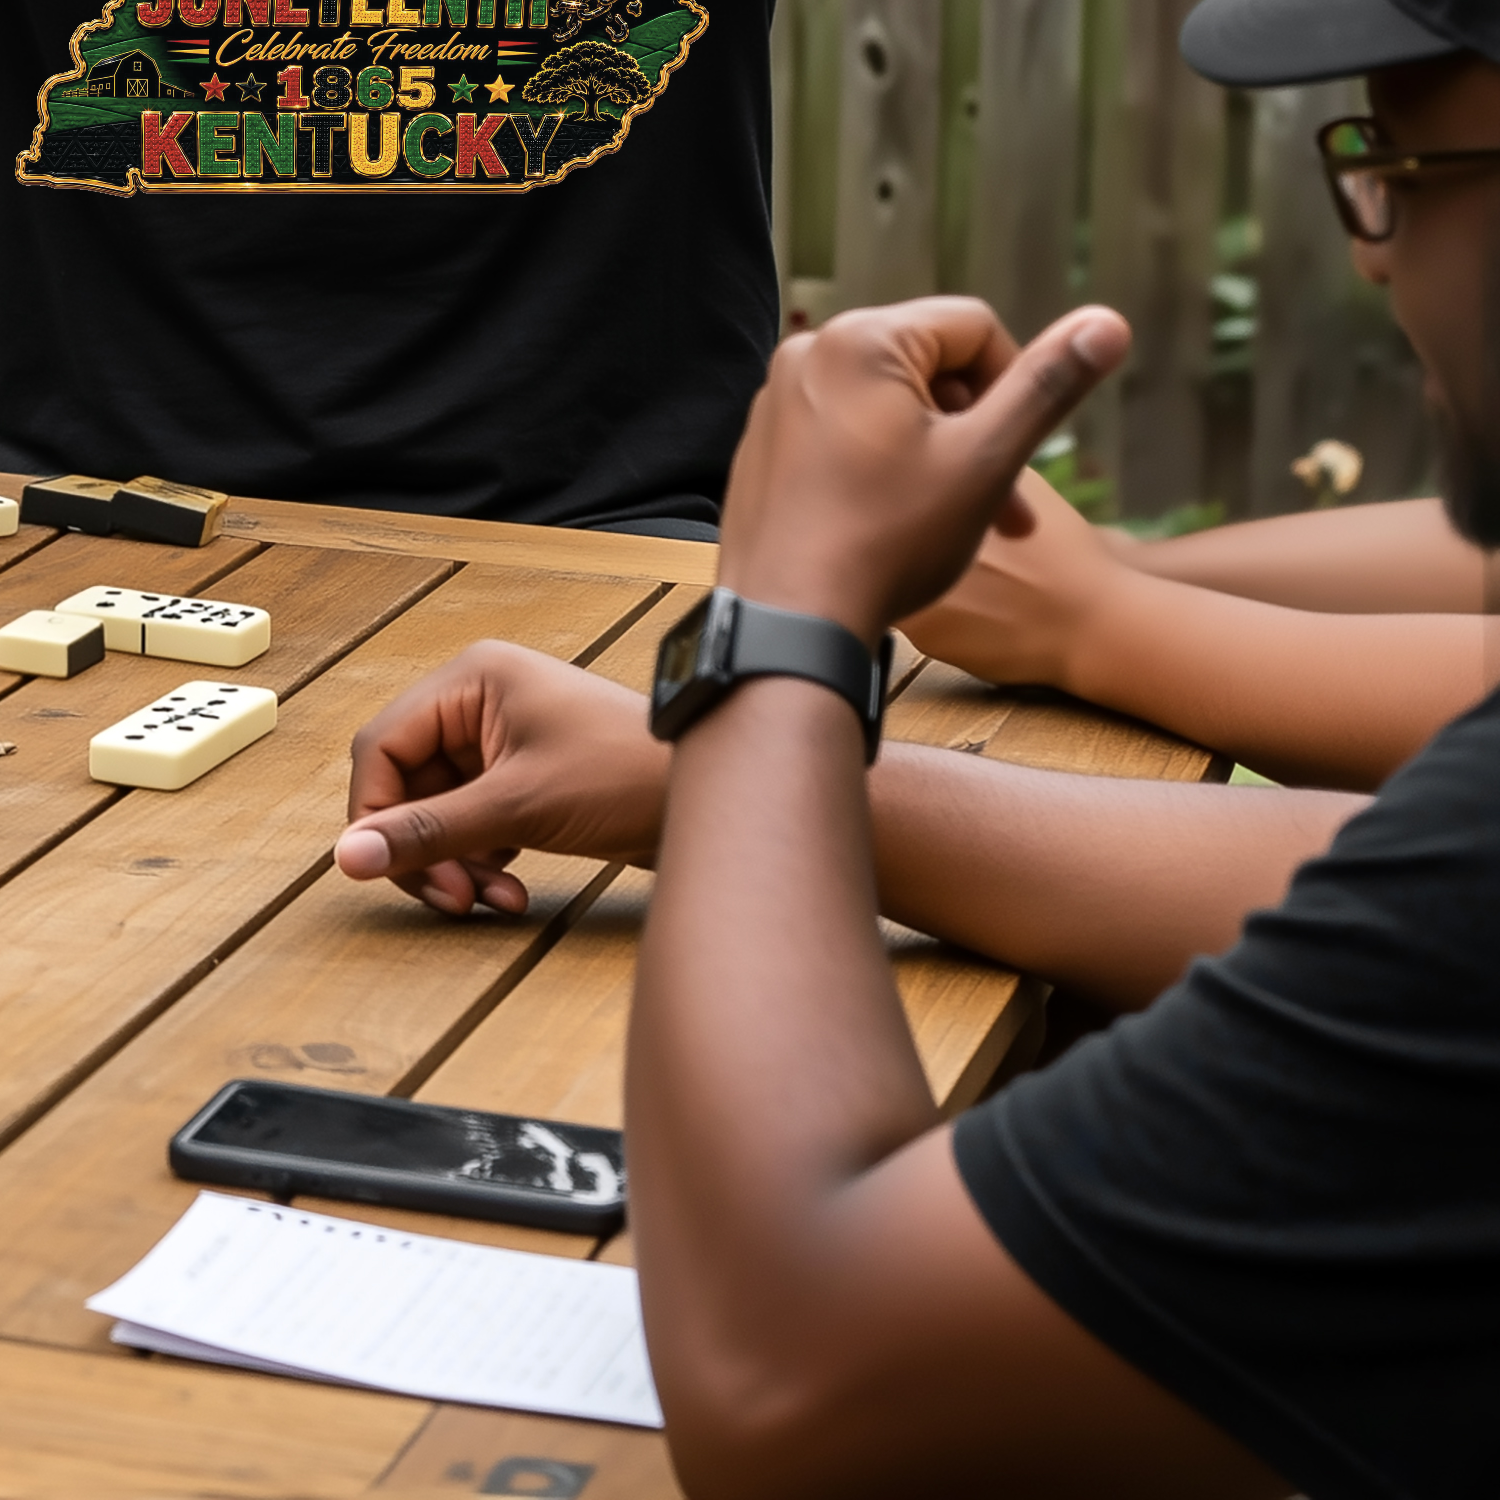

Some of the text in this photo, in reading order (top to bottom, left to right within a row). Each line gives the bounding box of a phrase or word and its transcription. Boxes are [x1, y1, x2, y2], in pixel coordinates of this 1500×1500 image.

[215, 28, 492, 67] Celebrate Freedom
[276, 64, 436, 111] 1865
[140, 111, 565, 179] KENTUCKY
